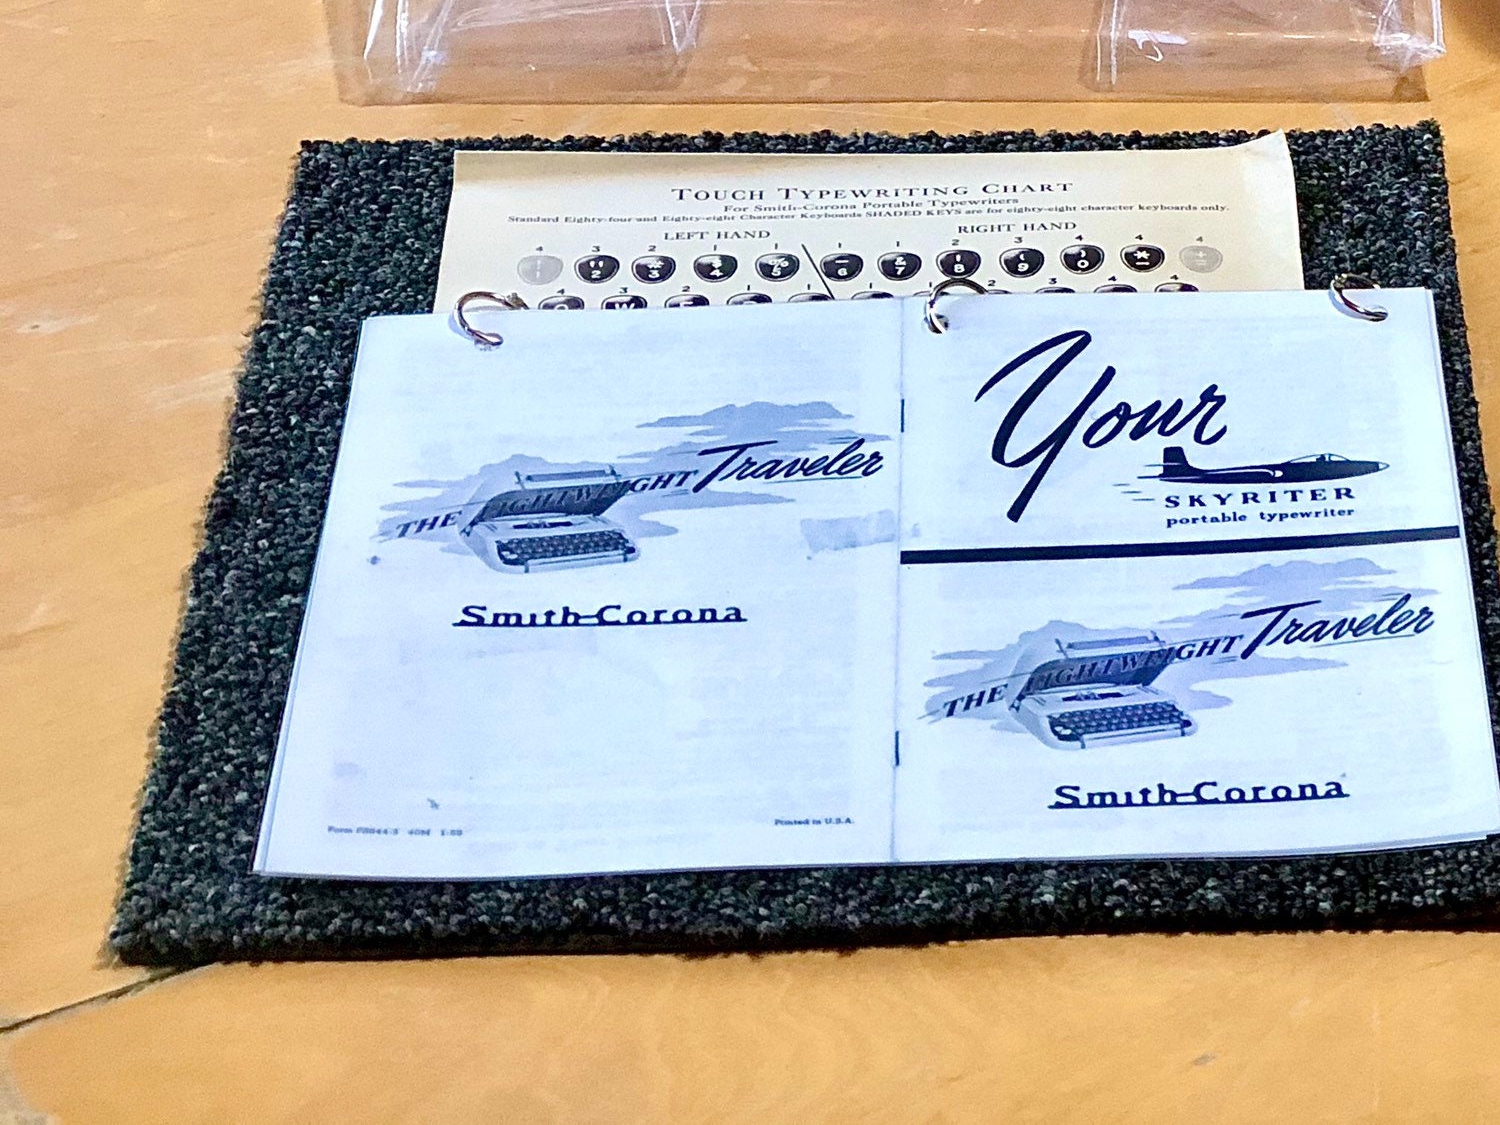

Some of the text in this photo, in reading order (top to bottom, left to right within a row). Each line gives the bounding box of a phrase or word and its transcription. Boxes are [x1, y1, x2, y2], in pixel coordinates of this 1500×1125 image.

[671, 183, 1074, 201] TOUCH TYPEWRITING CHART
[507, 215, 560, 224] Standard
[564, 216, 631, 225] Eighty-four
[636, 215, 657, 223] and
[662, 214, 736, 224] Eighty-eight
[739, 213, 796, 221] Character
[799, 211, 862, 220] Keyboards
[865, 210, 922, 218] SHADED
[925, 208, 963, 217] KEYS
[1006, 204, 1077, 214] eighty-eight
[1080, 204, 1134, 212] character
[1137, 203, 1198, 213] keyboards
[1200, 203, 1230, 213] only.
[724, 197, 1019, 213] For Smith-Corona Portable Typewriters
[663, 229, 771, 241] LEFT HAND
[957, 221, 1077, 235] RIGHT HAND
[975, 330, 1228, 524] Your
[396, 510, 462, 538] THE
[692, 437, 884, 494] Traveler
[1164, 487, 1356, 509] SKYRITER
[1165, 507, 1355, 528] portable typewriter
[453, 604, 747, 627] Smith-Corona
[943, 683, 1009, 717] THE
[1240, 593, 1435, 660] Traveler
[1049, 781, 1349, 808] Smith-Corona
